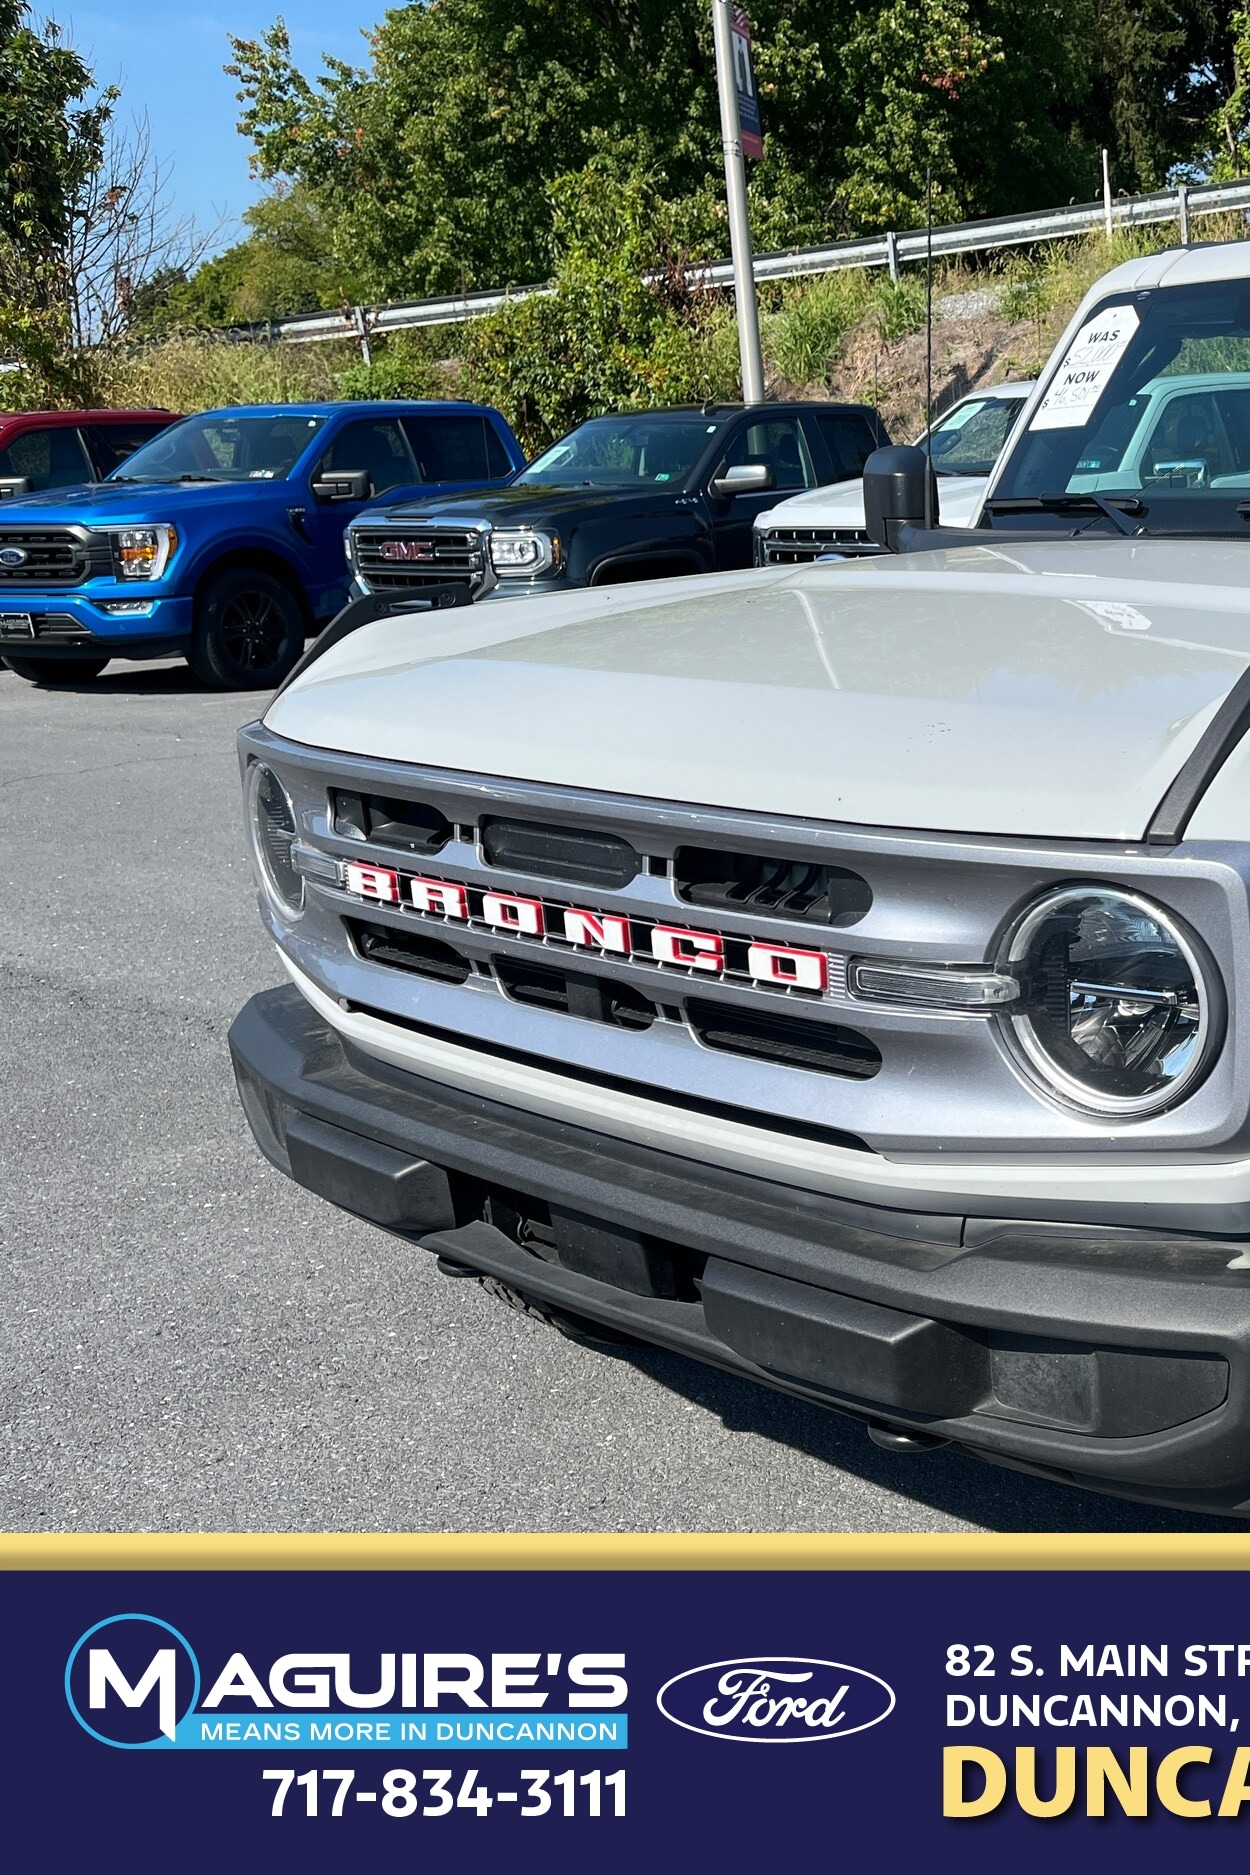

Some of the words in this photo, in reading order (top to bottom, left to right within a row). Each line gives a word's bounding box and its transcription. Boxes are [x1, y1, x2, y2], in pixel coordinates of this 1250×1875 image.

[1088, 330, 1120, 344] WAS
[1063, 370, 1100, 386] NOW
[380, 542, 436, 560] GMC
[347, 862, 828, 991] BRONCO
